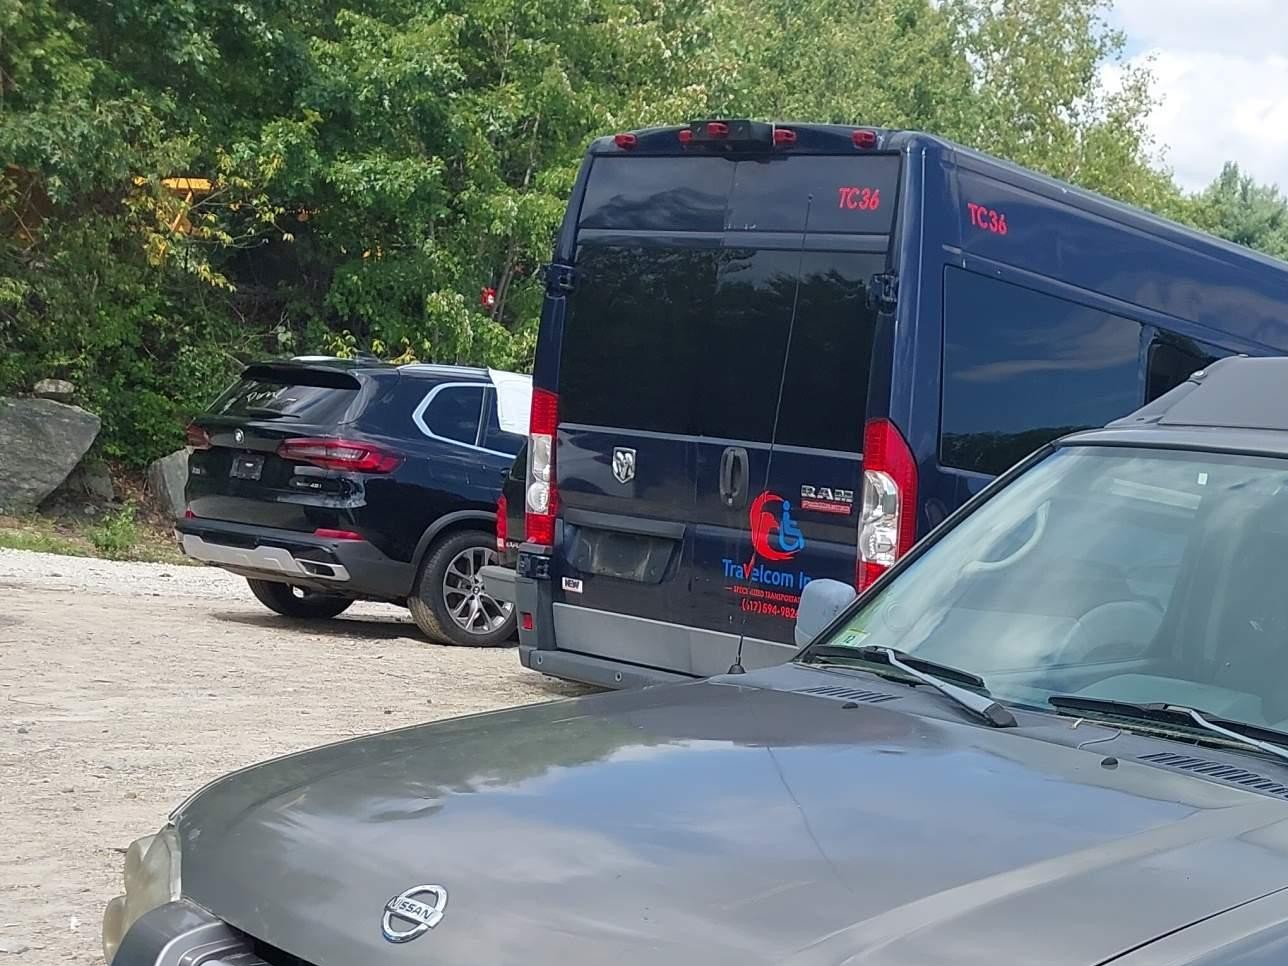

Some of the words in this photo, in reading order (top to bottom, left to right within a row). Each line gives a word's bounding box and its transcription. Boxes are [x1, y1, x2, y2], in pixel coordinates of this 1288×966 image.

[838, 187, 880, 210] TC36
[967, 202, 1008, 235] TC36
[801, 485, 854, 502] RAM
[721, 557, 794, 588] Travelcom
[799, 571, 812, 590] In
[388, 896, 434, 920] NISSAN
